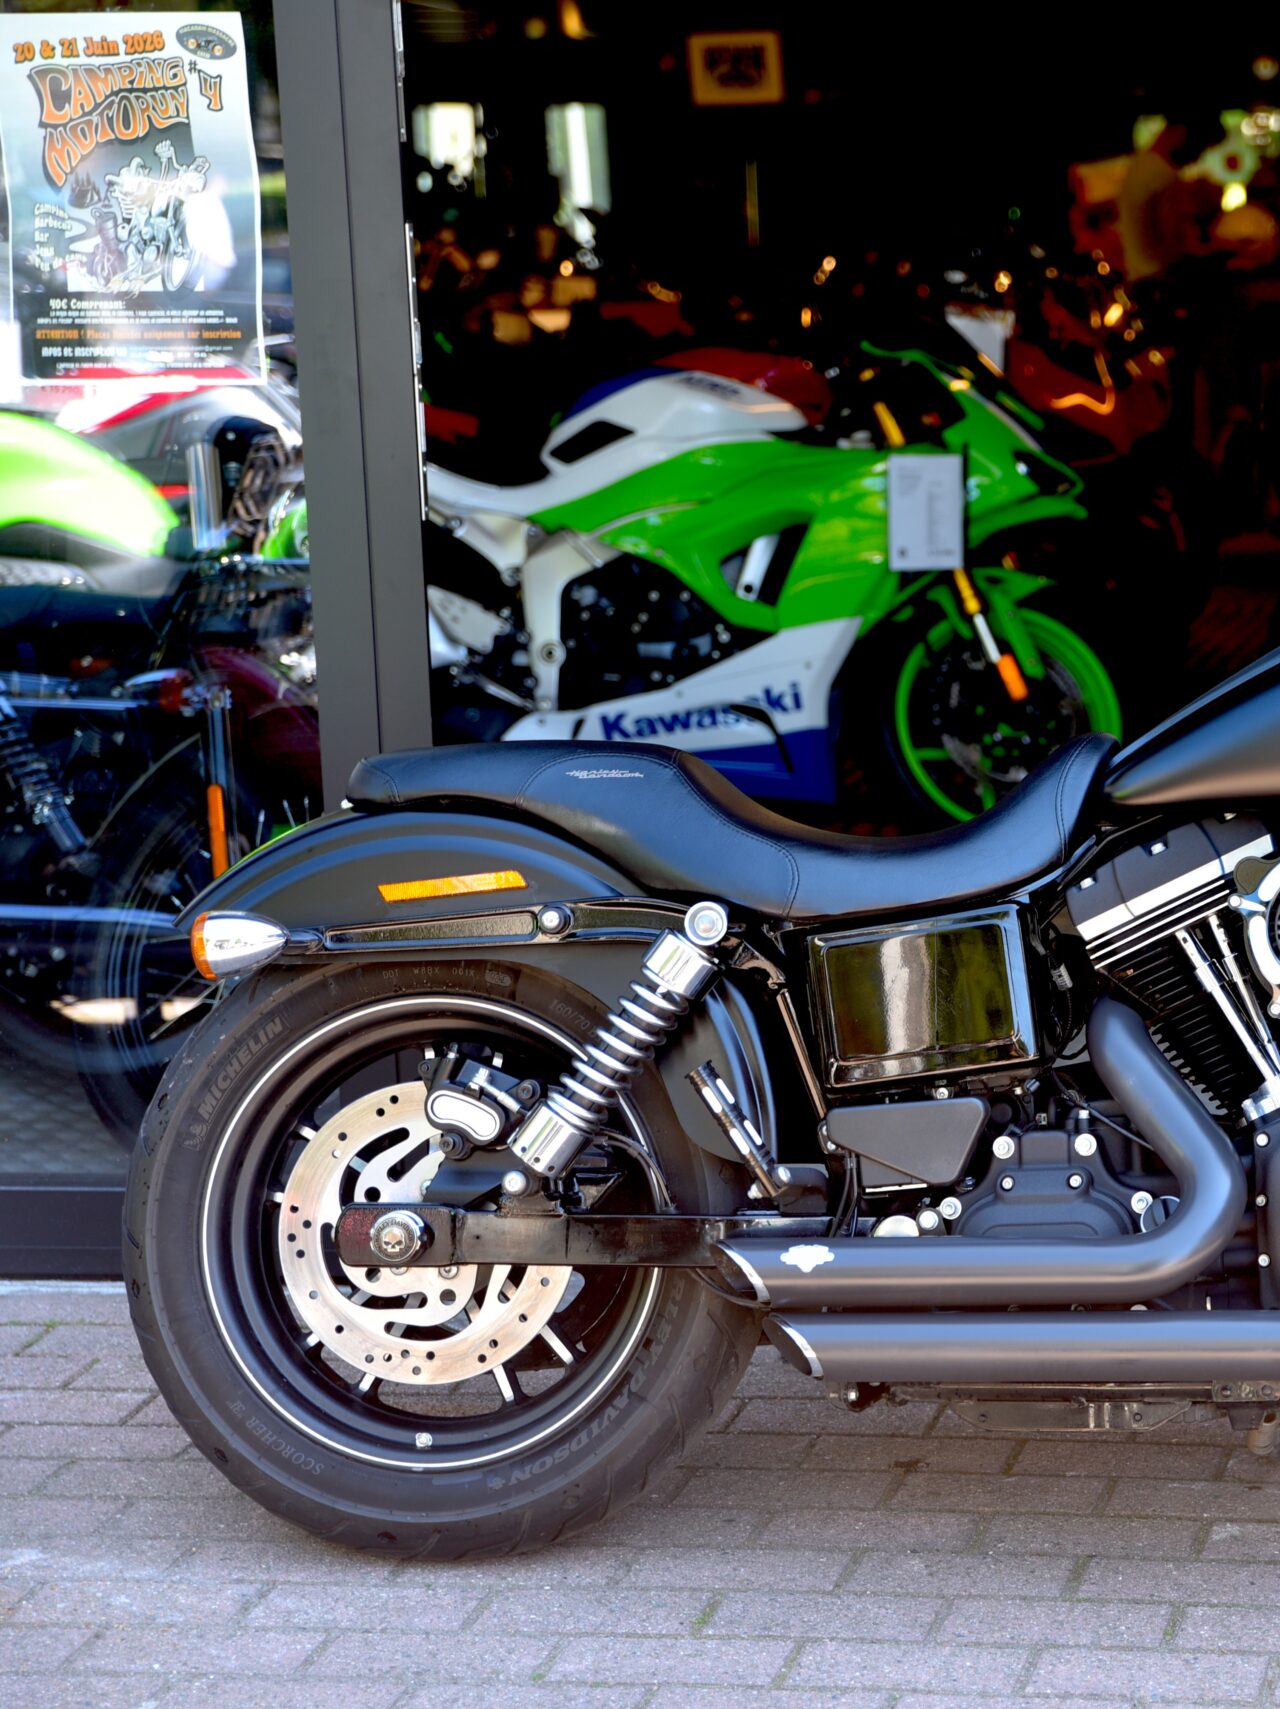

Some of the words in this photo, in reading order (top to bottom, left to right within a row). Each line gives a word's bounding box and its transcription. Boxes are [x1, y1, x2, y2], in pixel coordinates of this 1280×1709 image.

[13, 41, 35, 62] 20
[40, 40, 55, 59] &
[59, 37, 79, 57] 21
[83, 36, 119, 56] Juin
[123, 31, 165, 54] 2026
[44, 88, 190, 192] MOTORUN
[601, 682, 803, 741] Kawaski
[198, 1015, 284, 1122] MICHELIN
[245, 1416, 325, 1475] SCORCHER
